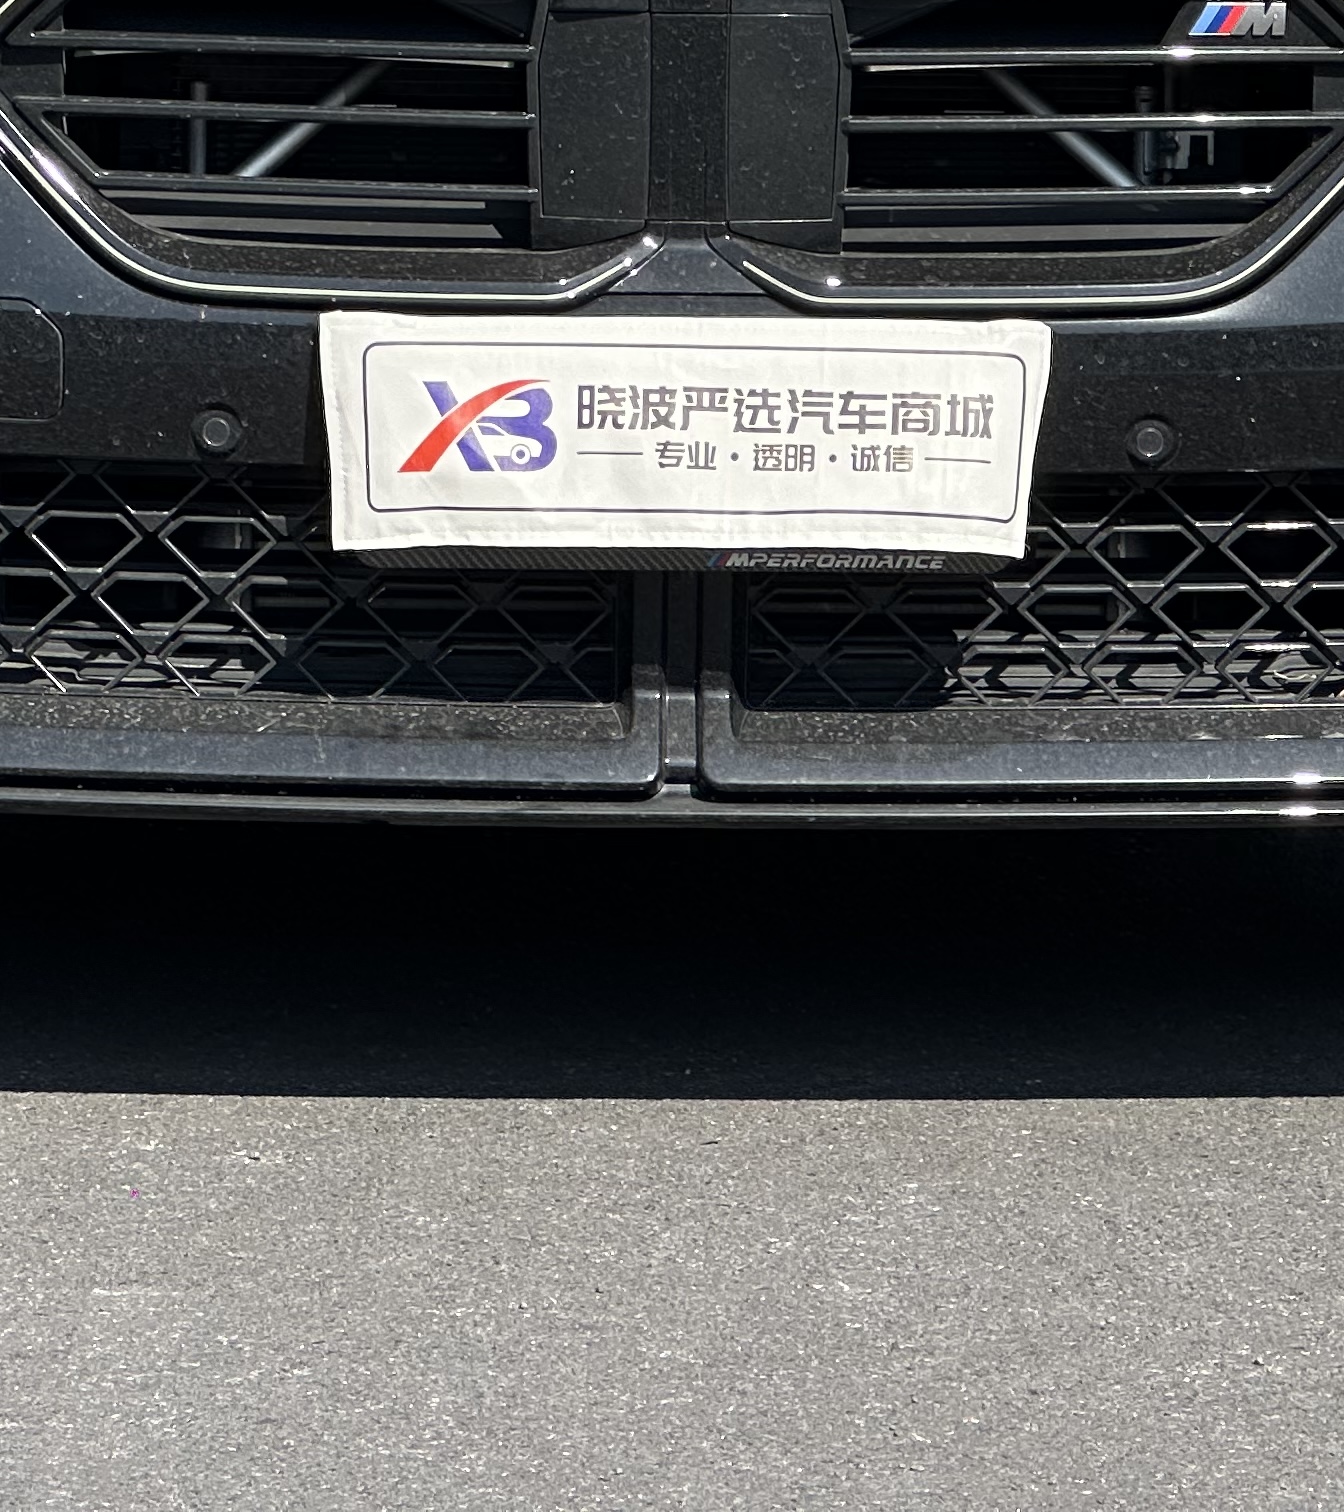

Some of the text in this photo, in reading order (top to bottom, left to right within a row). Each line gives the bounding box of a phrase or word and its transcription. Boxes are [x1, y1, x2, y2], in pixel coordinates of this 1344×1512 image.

[575, 383, 994, 441] 晓波严选汽车商城
